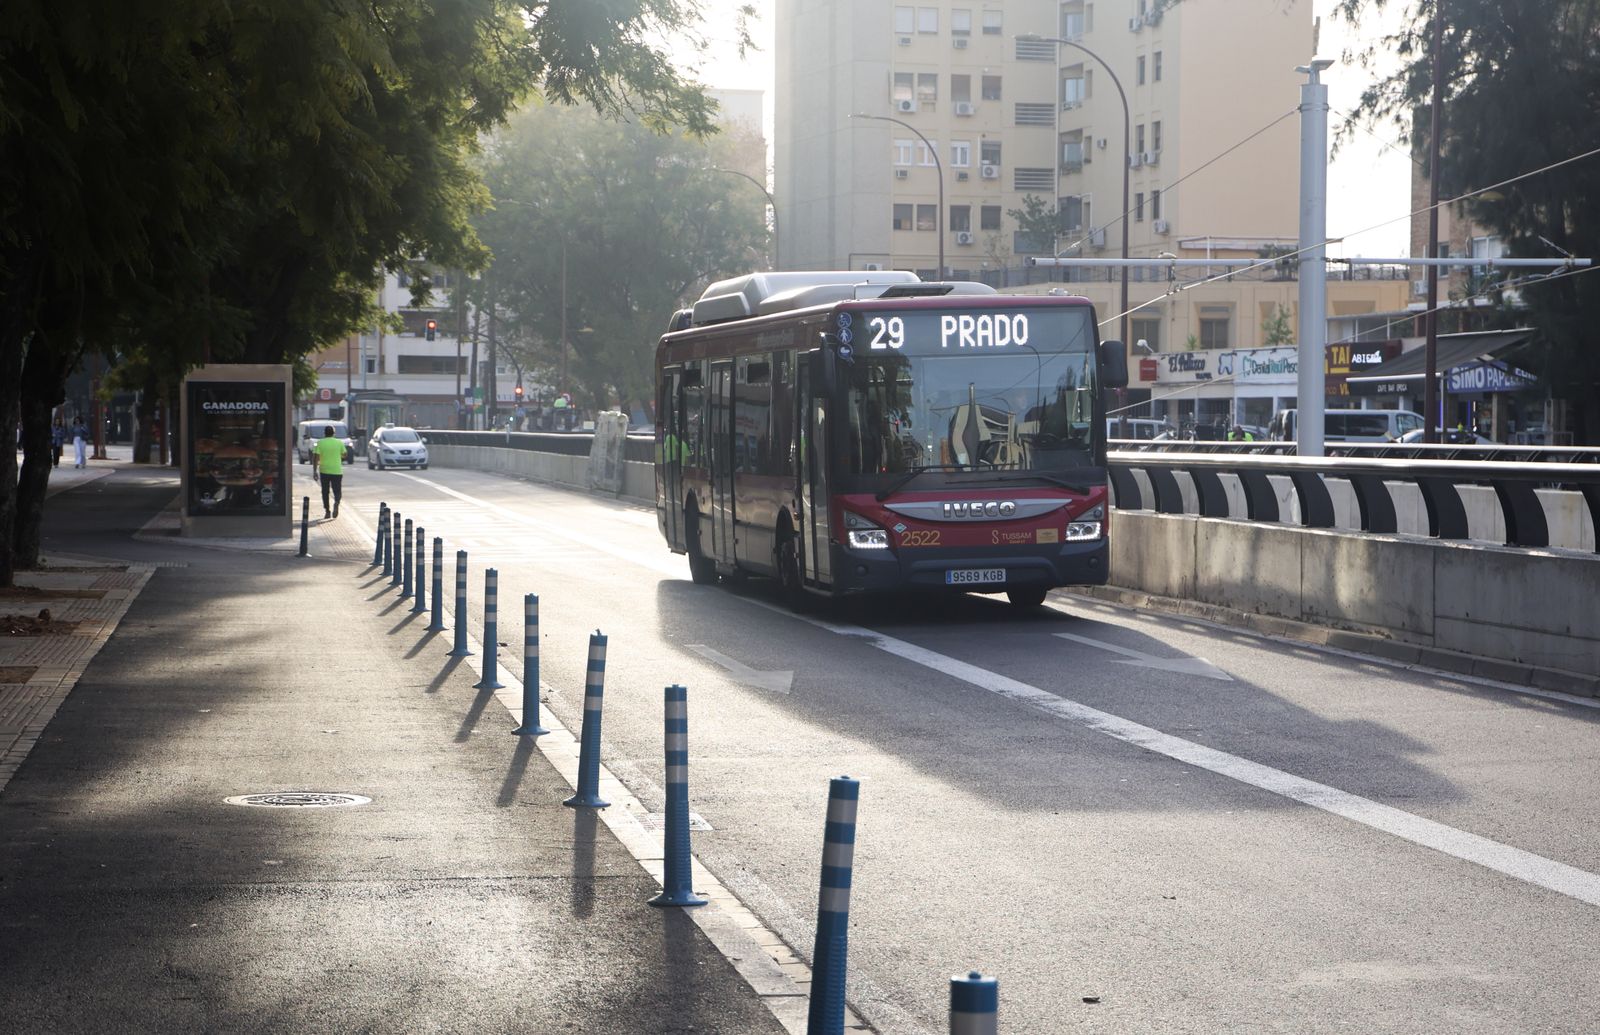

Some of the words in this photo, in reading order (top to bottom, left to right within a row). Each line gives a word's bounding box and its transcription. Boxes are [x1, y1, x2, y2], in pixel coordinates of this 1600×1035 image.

[870, 317, 904, 349] 29
[941, 314, 1028, 347] PRADO
[1283, 357, 1298, 374] Pasc
[202, 402, 269, 410] GANADORA
[943, 502, 1017, 518] IVECO
[901, 530, 941, 546] 2522
[1002, 532, 1032, 540] TUSSAM
[952, 572, 981, 583] 9569
[983, 571, 1003, 582] KGB
